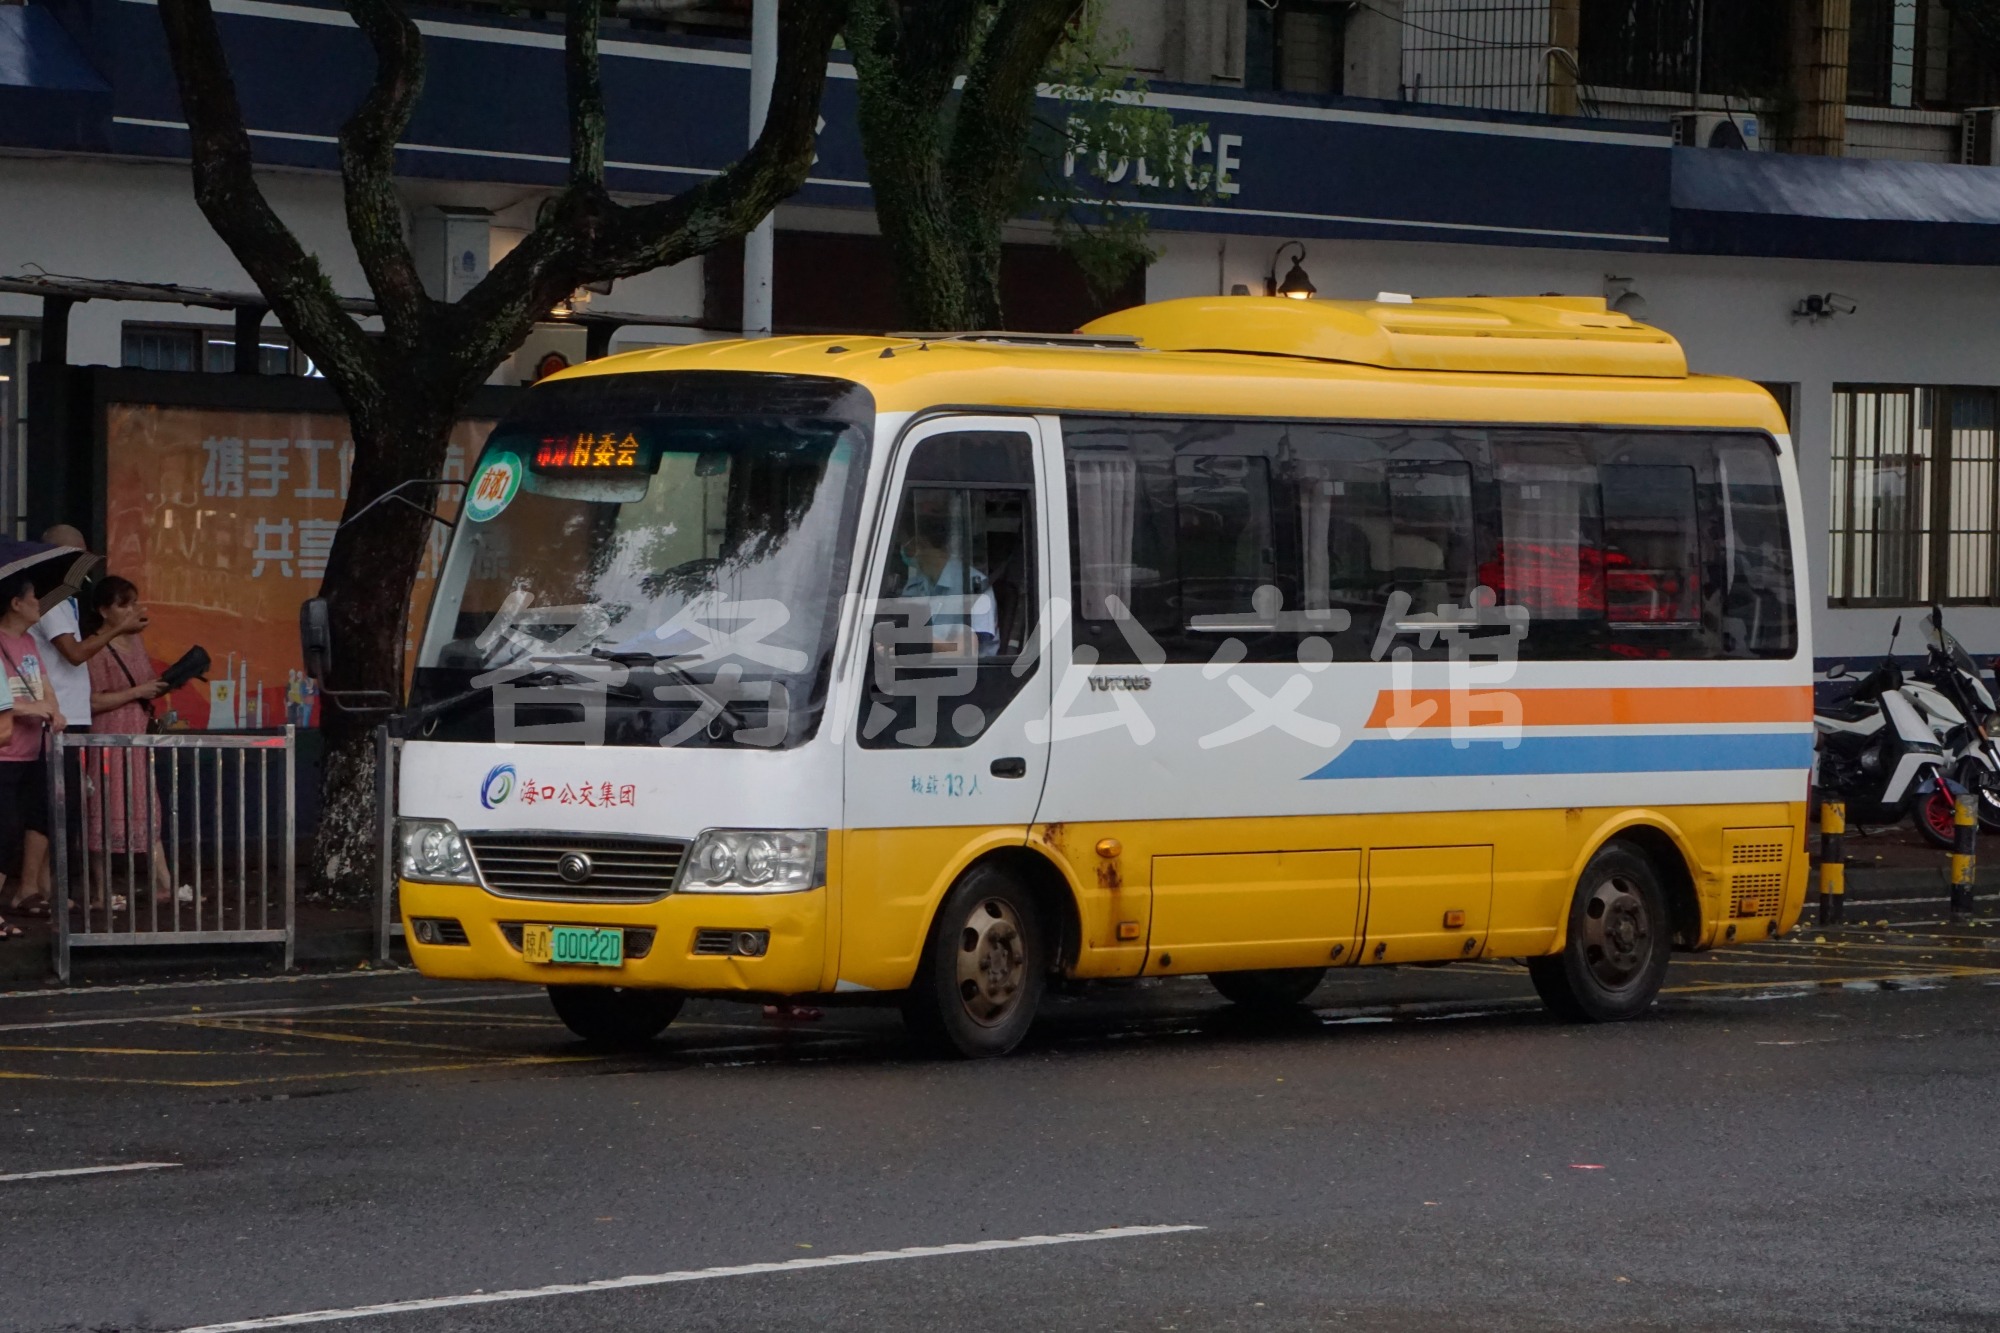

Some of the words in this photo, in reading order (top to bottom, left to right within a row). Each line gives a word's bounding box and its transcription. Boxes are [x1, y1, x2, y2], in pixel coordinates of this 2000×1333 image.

[1064, 116, 1243, 195] POLICE
[1087, 674, 1152, 692] YUTONG
[520, 778, 636, 808] 海口公交集团
